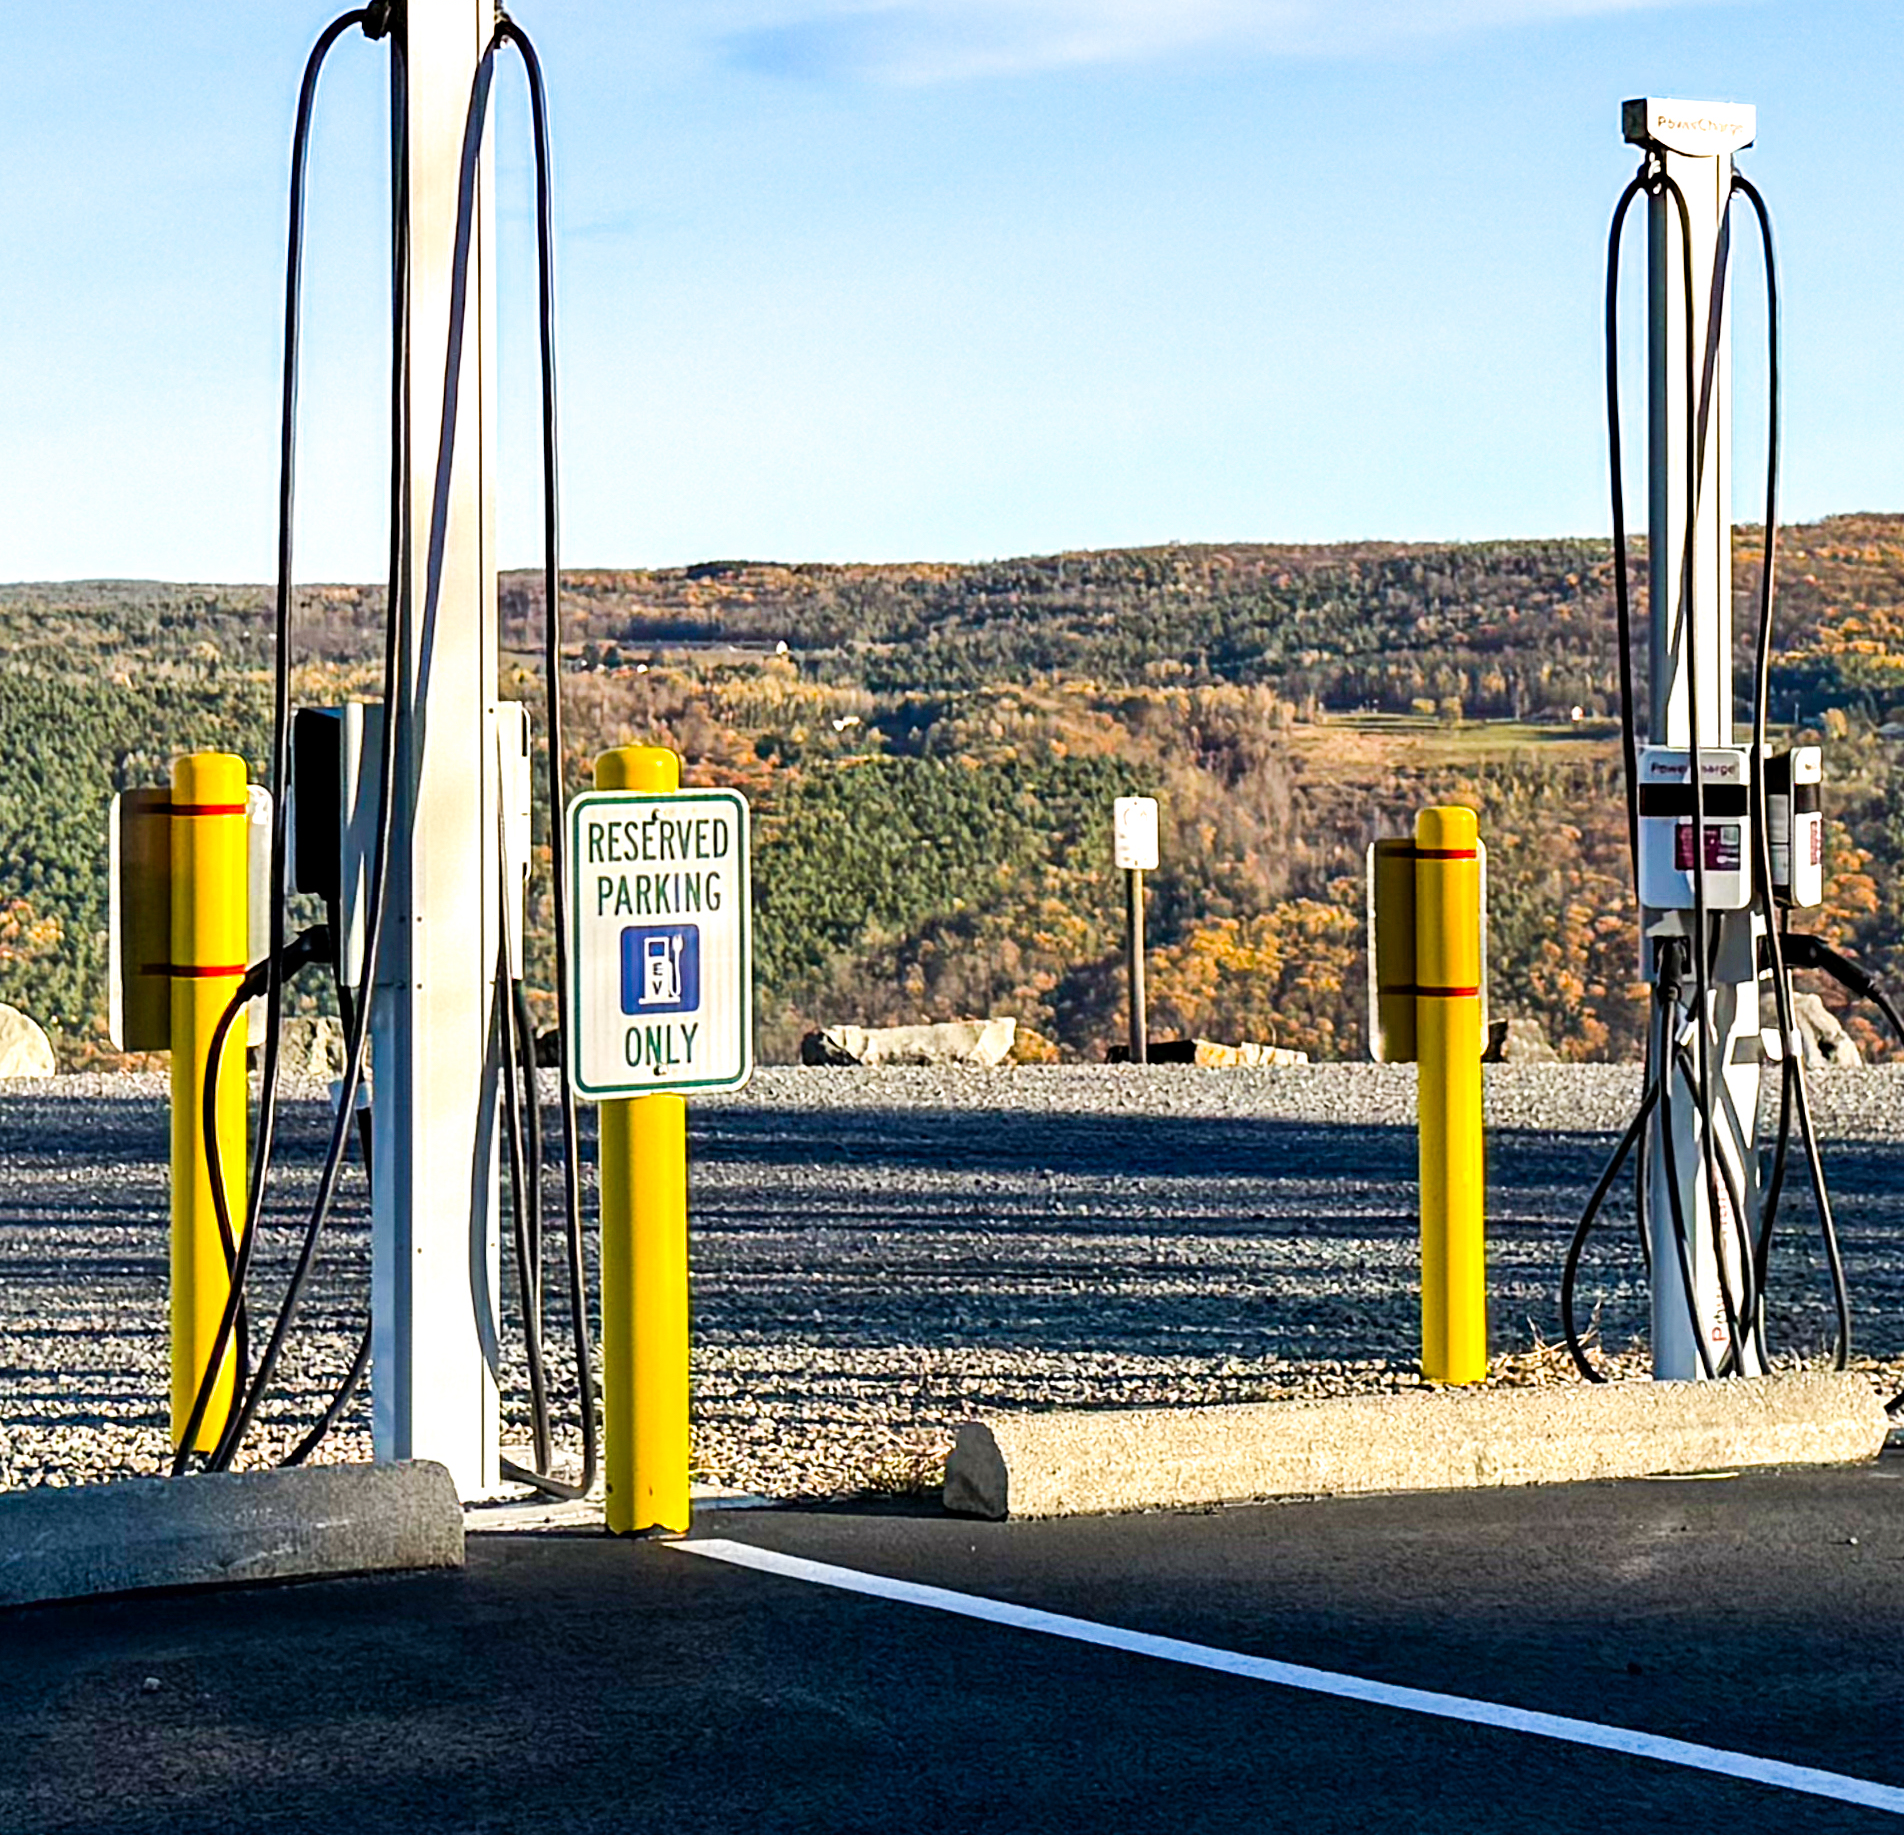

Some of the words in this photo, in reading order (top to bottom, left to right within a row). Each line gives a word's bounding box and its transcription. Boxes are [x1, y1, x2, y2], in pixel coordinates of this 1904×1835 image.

[588, 818, 729, 864] RESERVED
[597, 871, 722, 916] PARKING
[625, 1023, 699, 1067] ONLY
